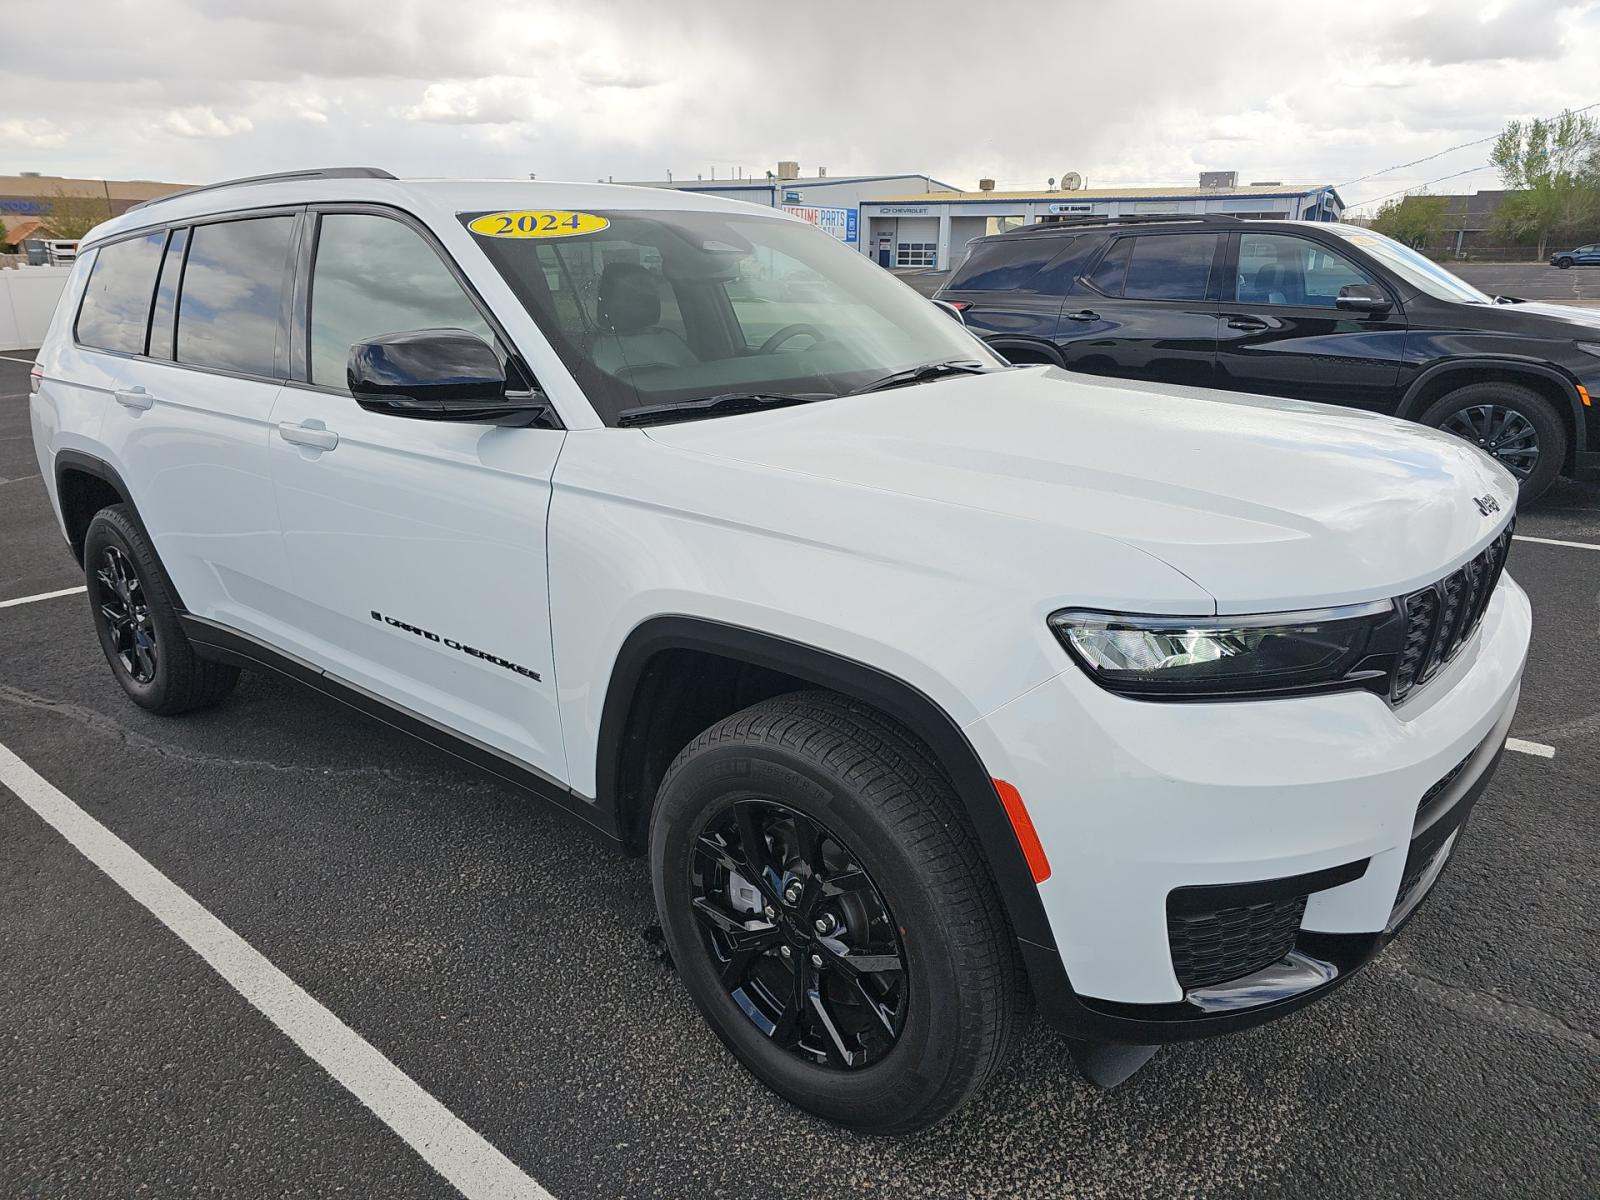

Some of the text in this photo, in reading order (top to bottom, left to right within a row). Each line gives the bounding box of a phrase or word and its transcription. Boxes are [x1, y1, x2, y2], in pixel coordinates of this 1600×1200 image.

[495, 213, 581, 234] 2024
[820, 209, 846, 226] PARTS
[1472, 494, 1501, 517] Jeep
[384, 616, 543, 683] GRAND CHEROKEE
